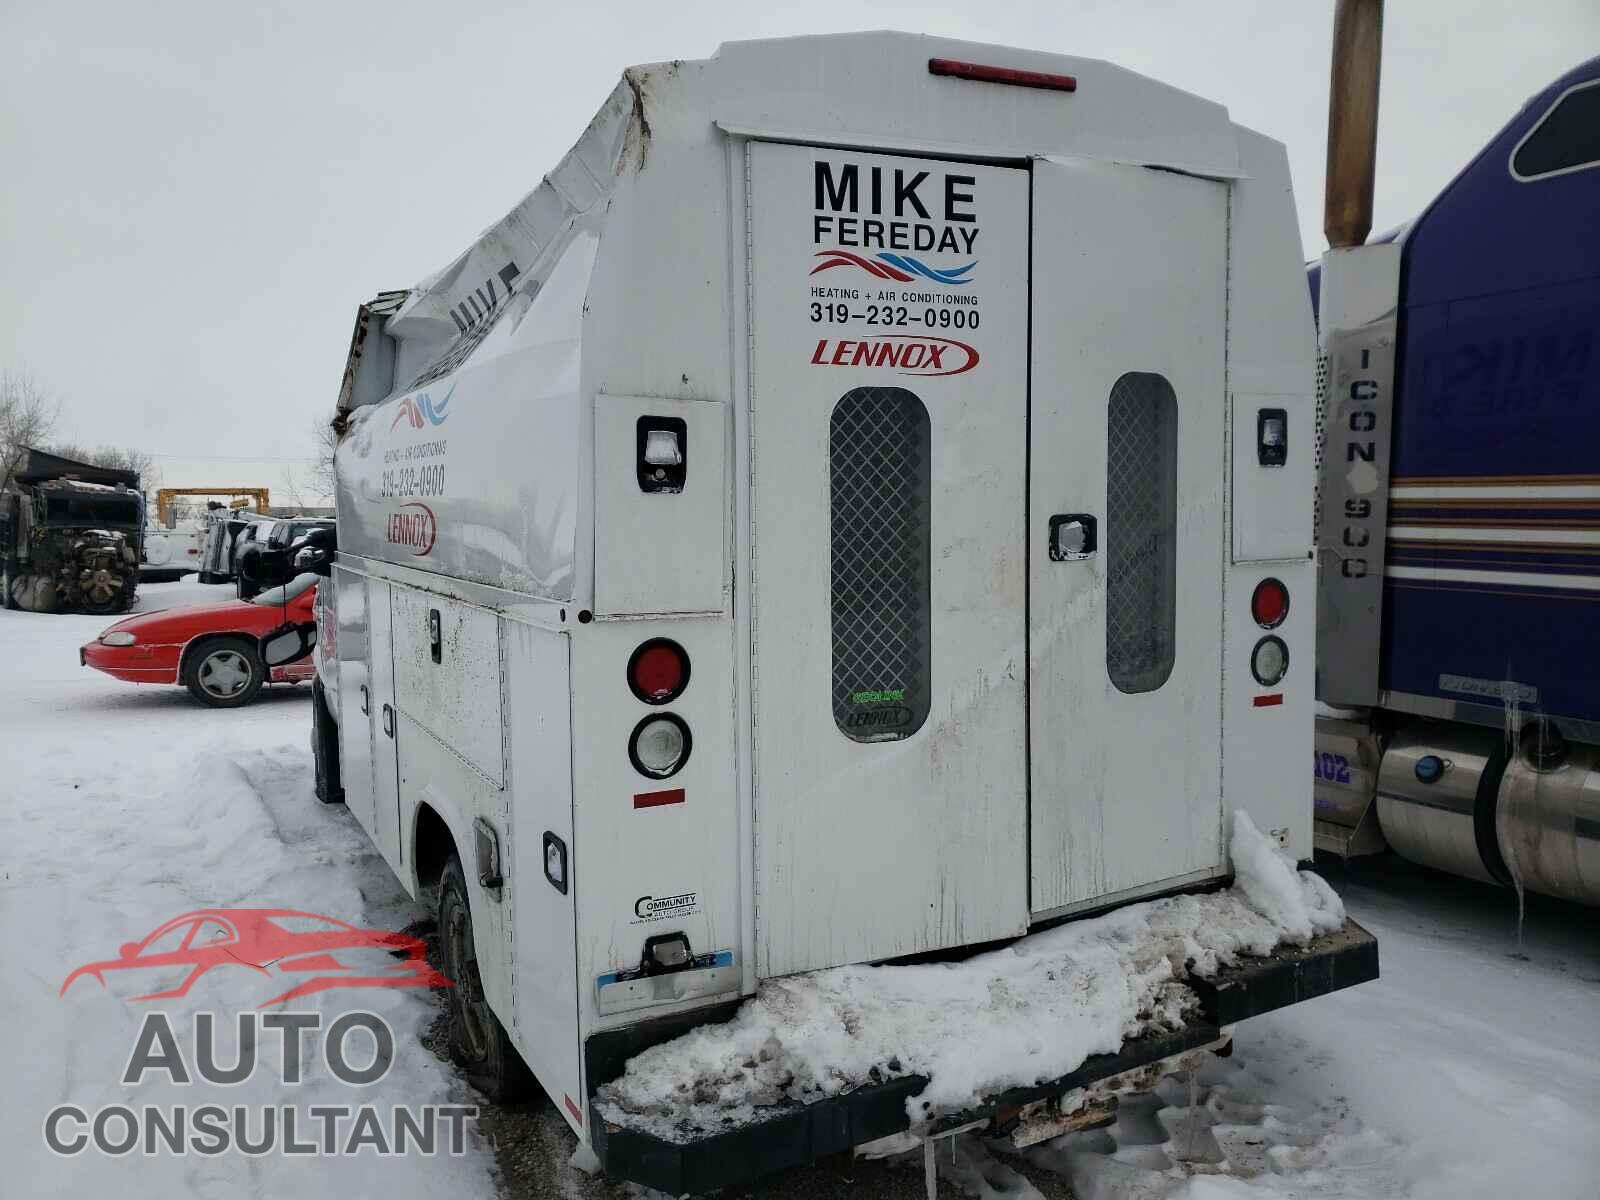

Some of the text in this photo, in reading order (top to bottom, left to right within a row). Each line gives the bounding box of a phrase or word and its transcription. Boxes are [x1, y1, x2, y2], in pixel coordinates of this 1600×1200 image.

[815, 161, 977, 223] MIKE
[814, 215, 980, 255] FEREDAY
[811, 287, 859, 300] HEATING
[878, 291, 896, 302] AIR
[902, 292, 978, 305] CONDITIONING
[810, 302, 980, 330] 319-232-0900
[811, 339, 948, 369] LENNOX
[381, 463, 445, 498] 319-232-0900
[1341, 349, 1378, 579] ICON 900
[387, 512, 429, 548] LENNOX
[635, 896, 696, 918] COMMUNITY
